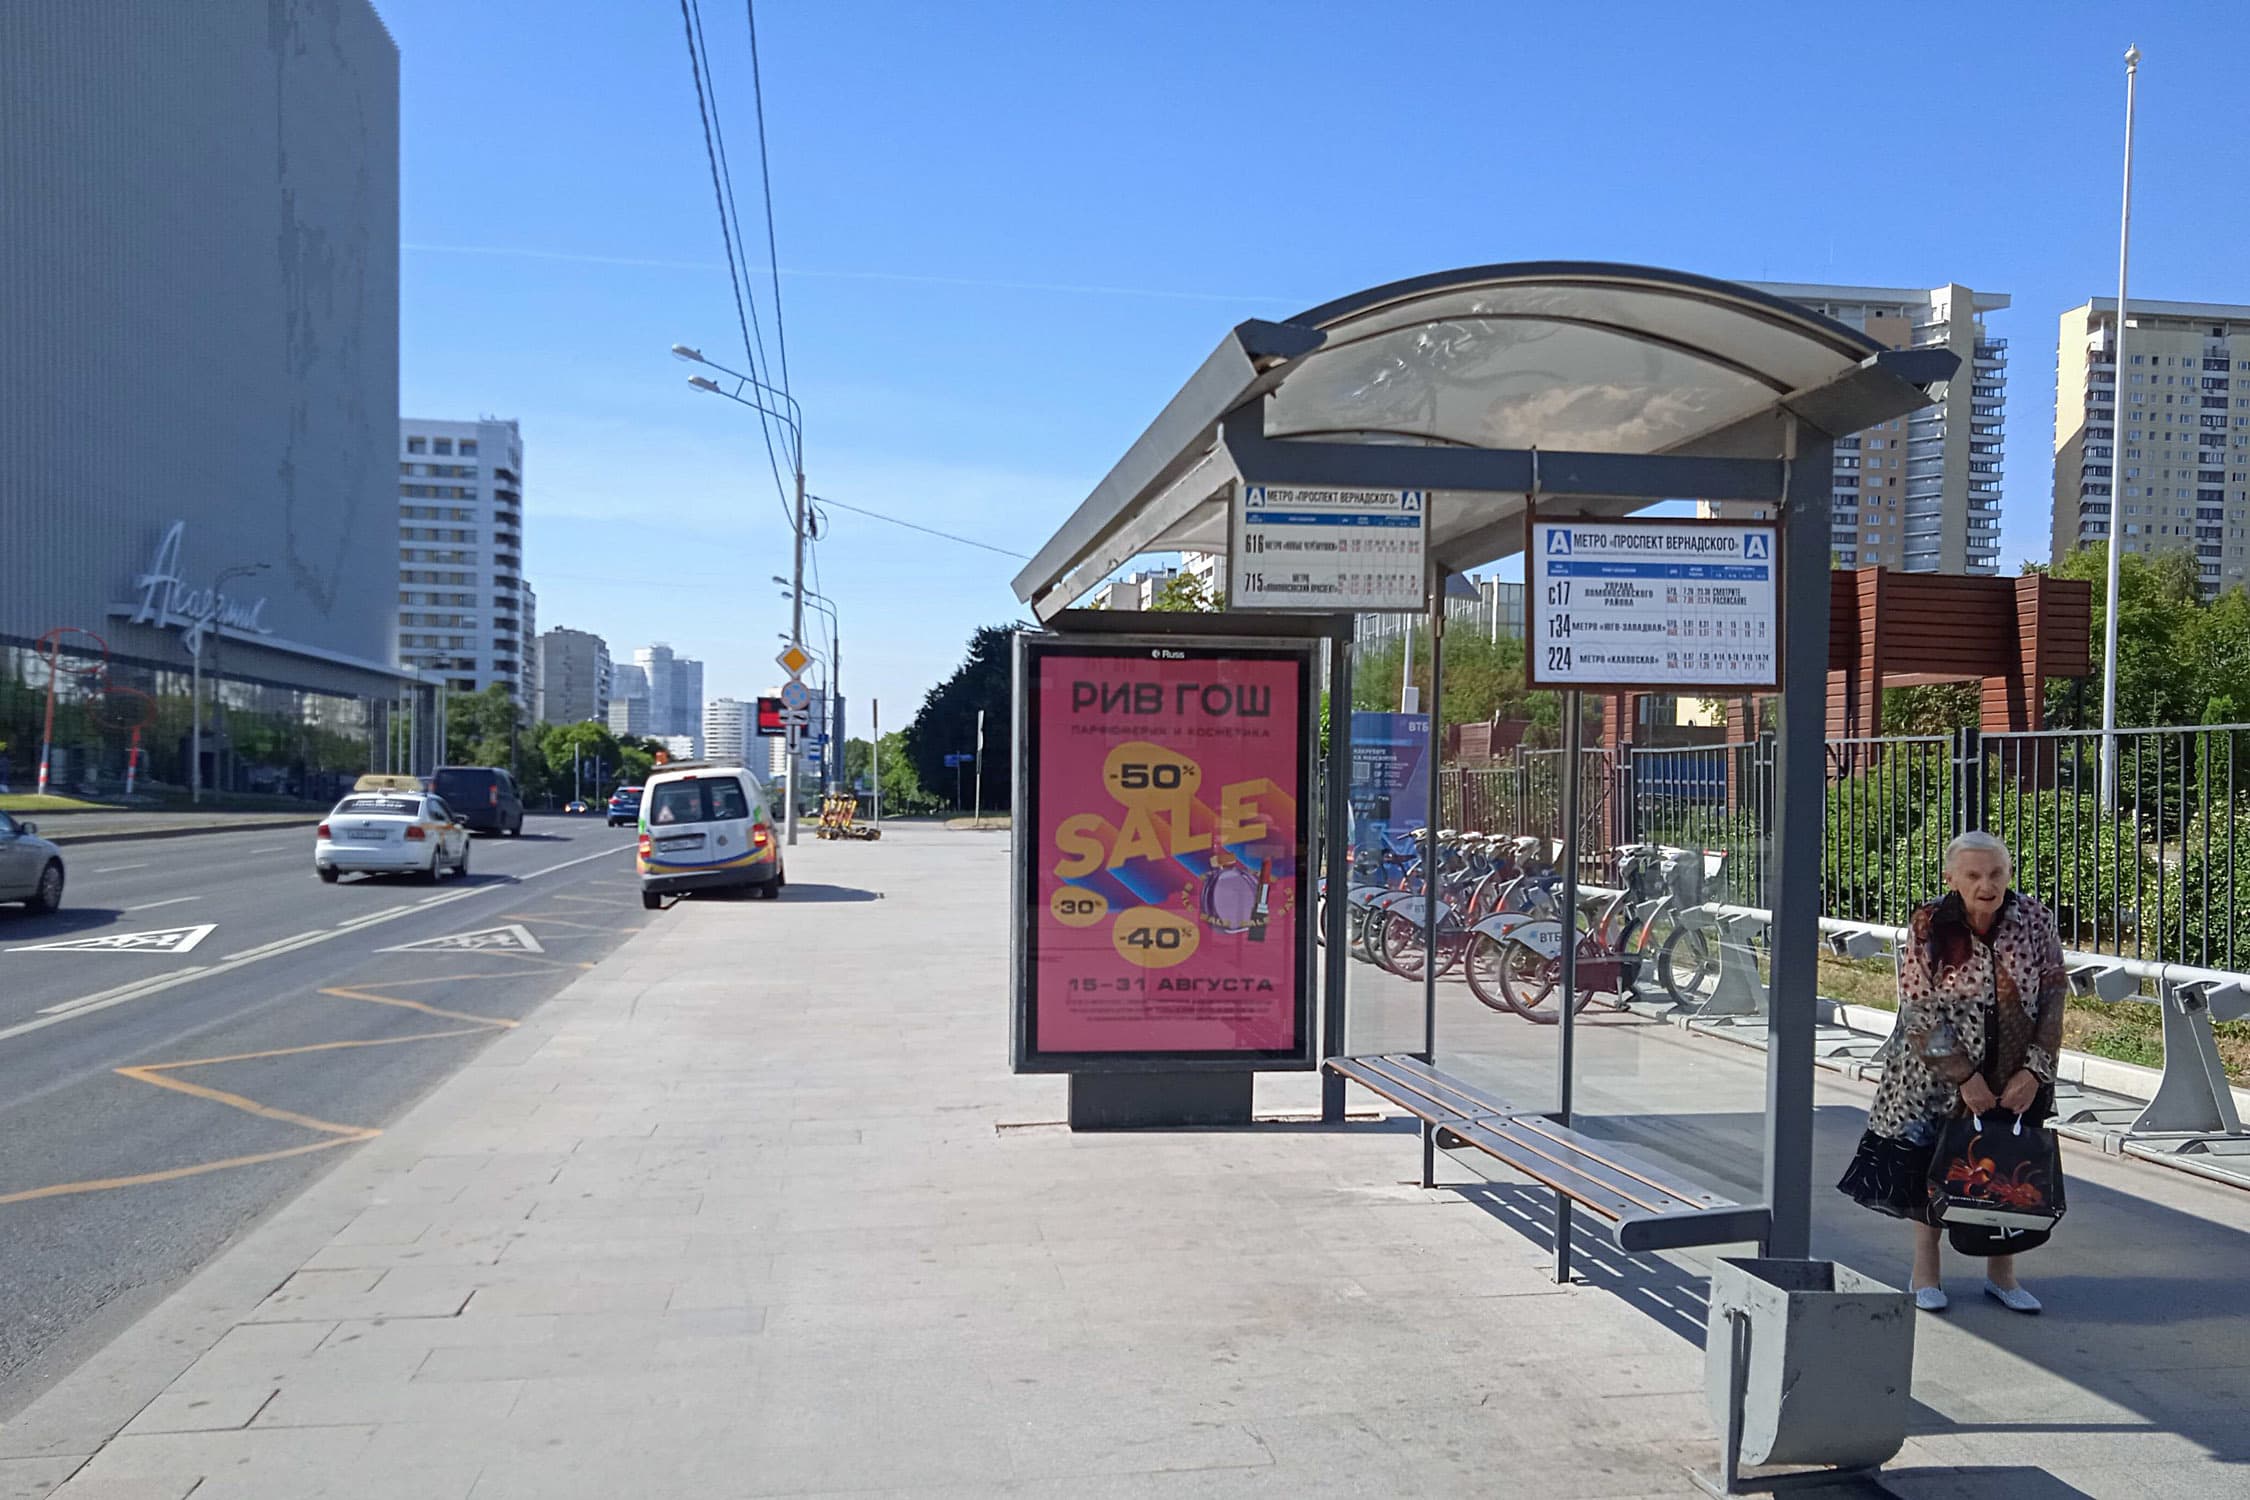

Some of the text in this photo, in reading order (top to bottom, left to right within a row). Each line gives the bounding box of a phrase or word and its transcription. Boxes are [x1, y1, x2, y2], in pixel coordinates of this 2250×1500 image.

[1267, 490, 1293, 503] МЕТРО
[1246, 535, 1264, 553] 616
[1574, 533, 1607, 548] МЕТРО
[1610, 535, 1663, 550] «ПРОСПЕКТ
[1666, 536, 1739, 552] ВЕРНАДСКОГО»
[1245, 573, 1263, 592] 715
[1549, 581, 1571, 605] с17
[1605, 598, 1634, 606] РАЙОНА
[1549, 614, 1570, 638] т34
[1572, 622, 1597, 631] МЕТРО
[1162, 650, 1184, 658] Russ
[1549, 647, 1570, 670] 224
[1580, 655, 1659, 664] МЕТРО «КАХОВСКАЯ»
[1072, 681, 1271, 717] РИВ ГОШ
[1188, 727, 1270, 738] КОСМЕТИКА
[1408, 721, 1429, 732] ВТБ
[1110, 764, 1195, 789] -50%
[1053, 778, 1268, 879] SALE
[1119, 928, 1192, 949] -40%
[1158, 978, 1273, 992] АВГУСТА
